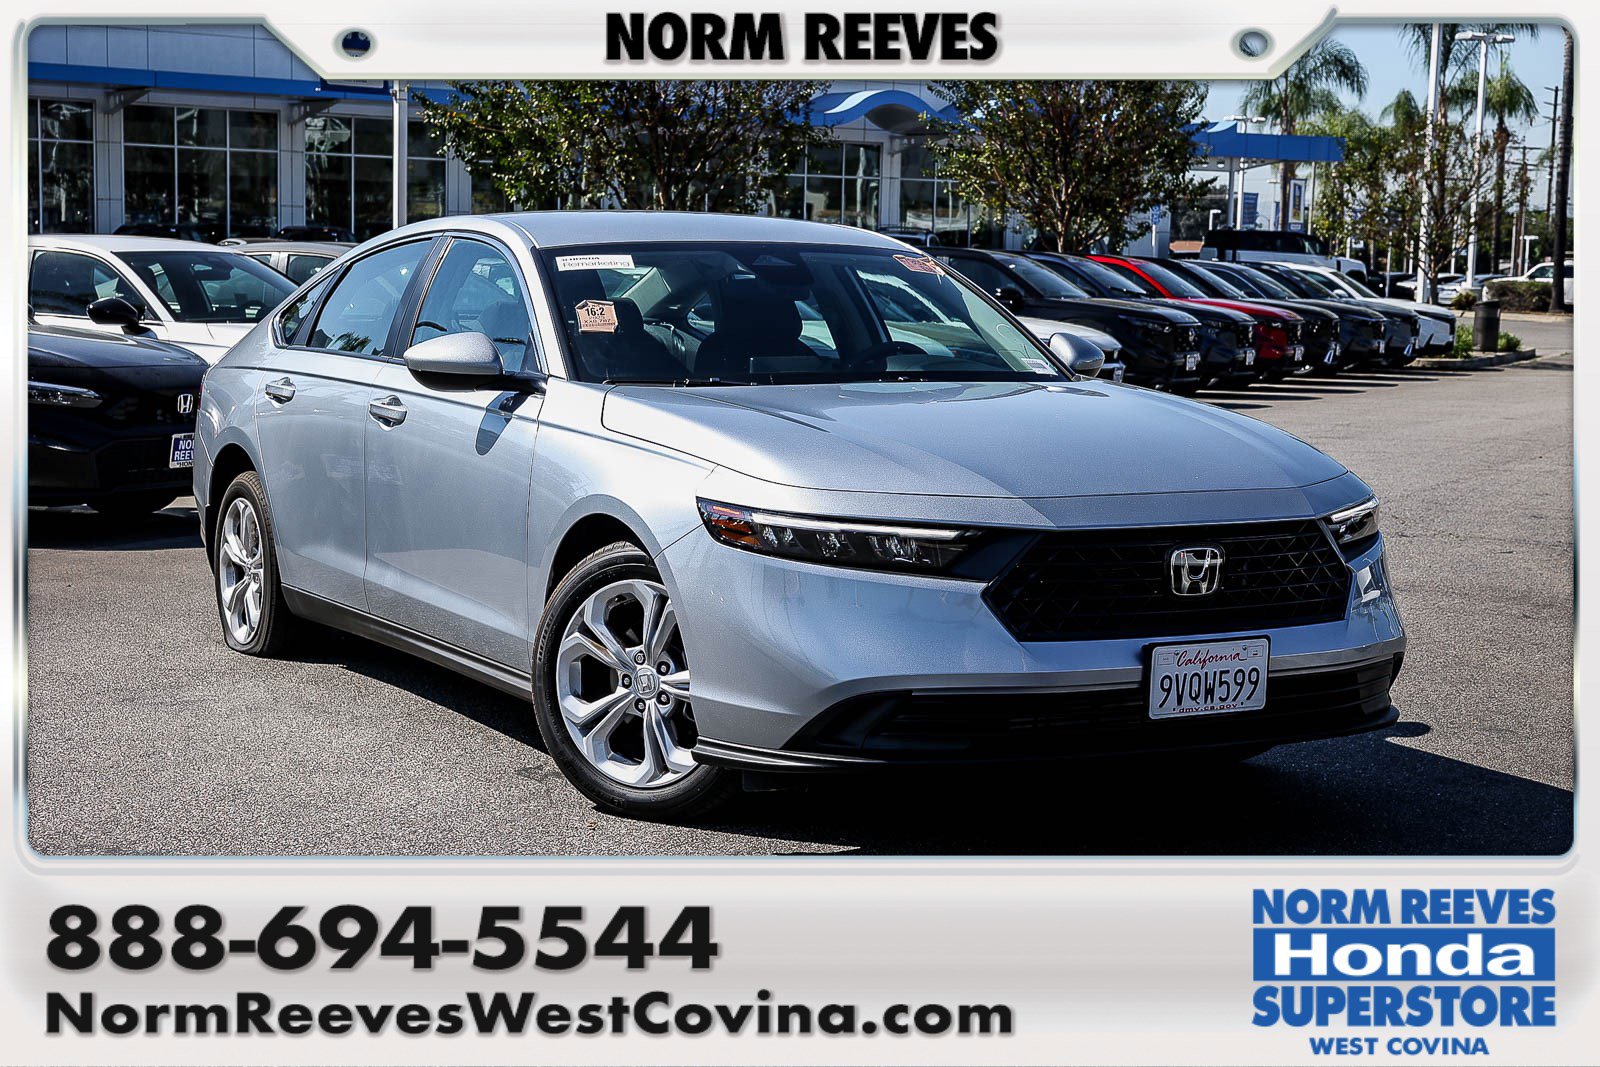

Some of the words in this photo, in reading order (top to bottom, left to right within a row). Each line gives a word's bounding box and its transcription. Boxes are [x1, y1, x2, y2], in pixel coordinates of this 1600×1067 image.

[562, 260, 631, 268] Remarketing
[1176, 649, 1247, 669] California
[1158, 667, 1260, 708] 9VQW599
[1178, 703, 1238, 713] dmv.ca.gov
